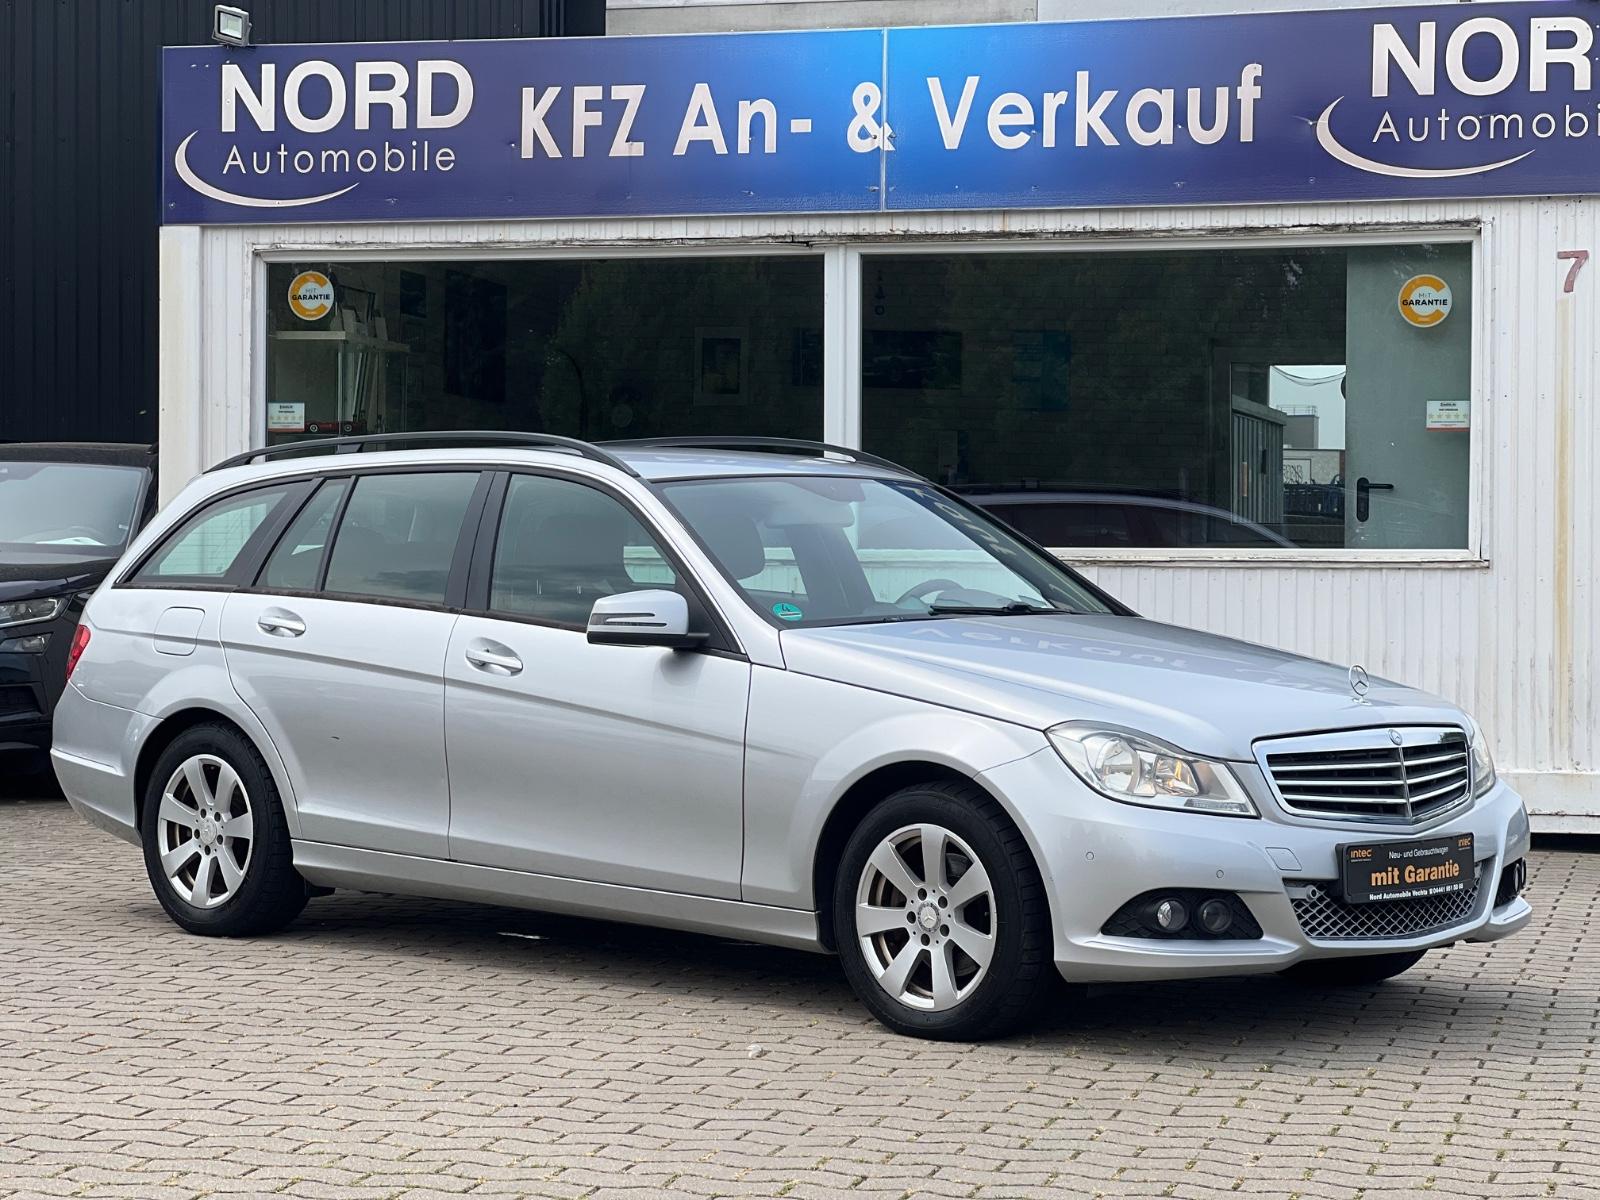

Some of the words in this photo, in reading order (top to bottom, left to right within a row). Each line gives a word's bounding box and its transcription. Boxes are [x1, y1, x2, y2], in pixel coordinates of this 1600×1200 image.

[221, 60, 474, 133] NORD
[521, 84, 647, 158] KFZ
[672, 82, 812, 156] An-
[846, 81, 896, 153] &
[926, 62, 1263, 150] Verkauf
[222, 140, 456, 175] Automobile
[1557, 249, 1589, 293] 7
[291, 293, 331, 301] GARANTIE
[1402, 298, 1448, 306] GARANTIE
[1371, 865, 1400, 887] mit
[1404, 860, 1460, 884] Garantie
[1369, 893, 1382, 901] Nord
